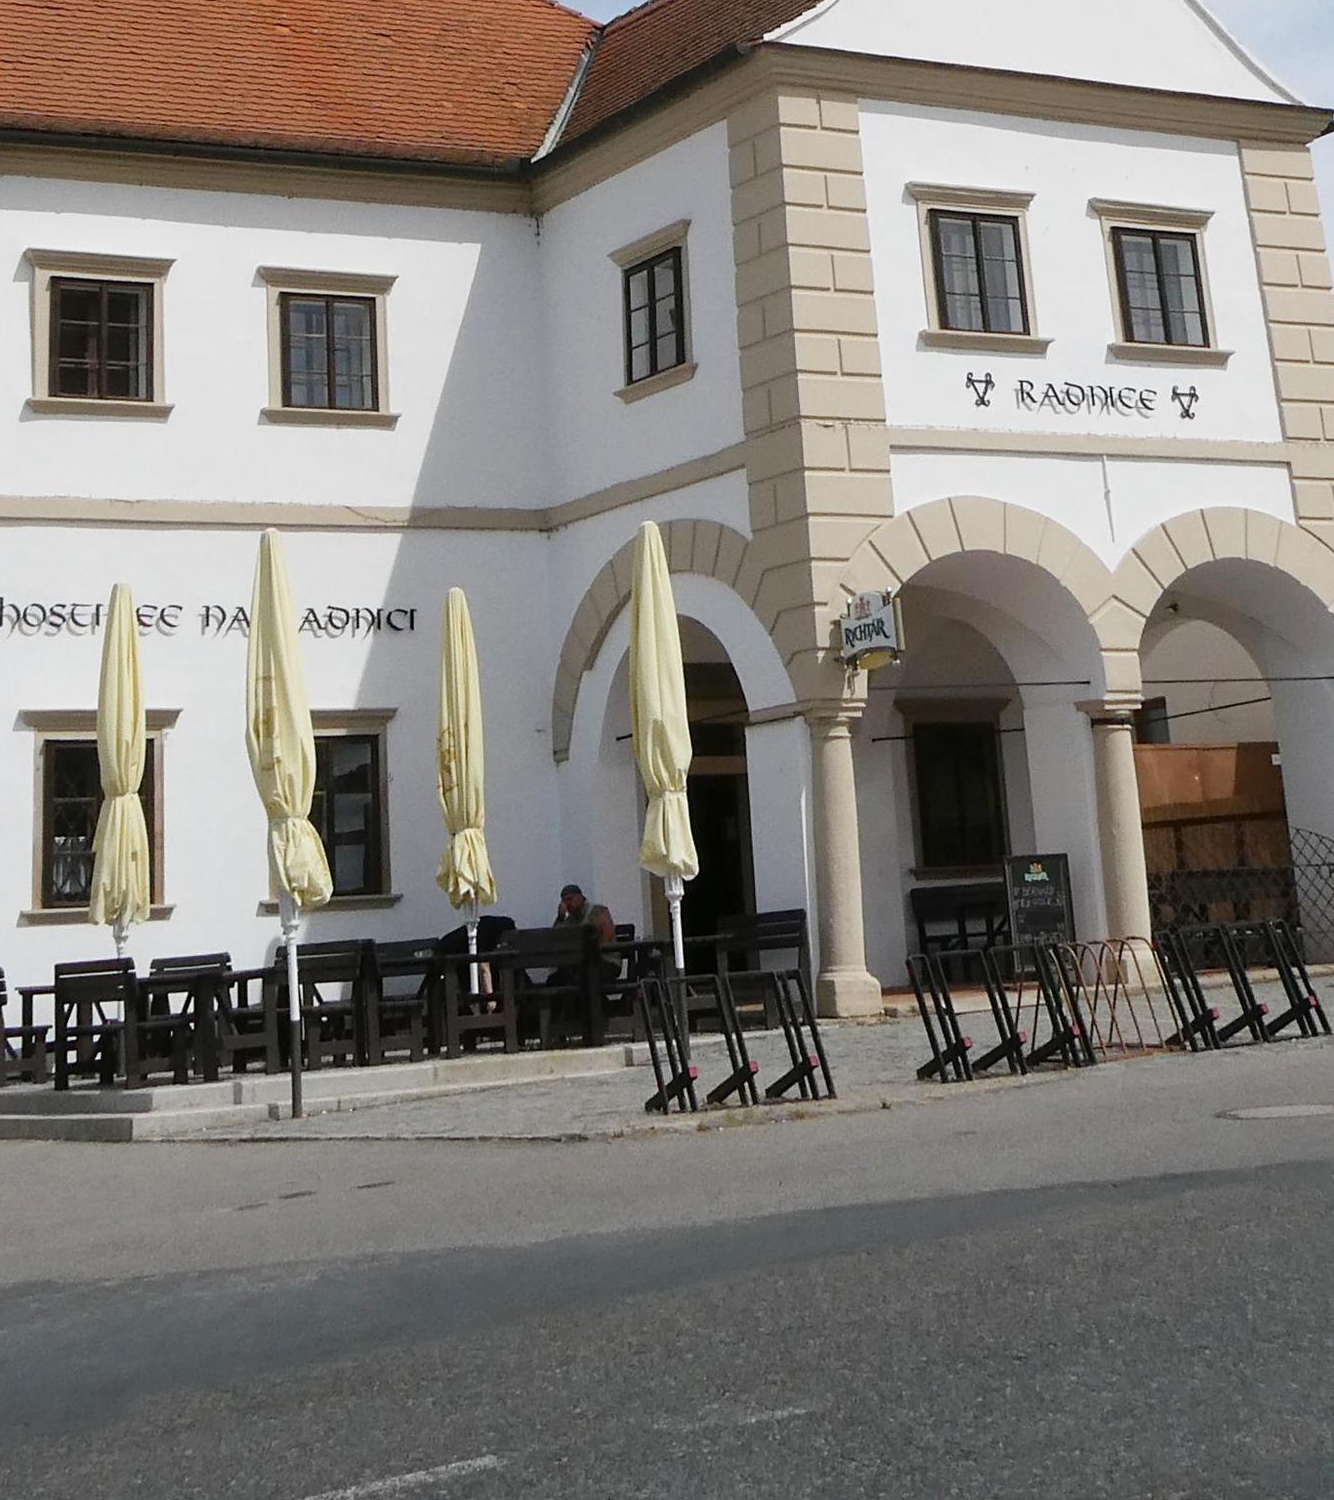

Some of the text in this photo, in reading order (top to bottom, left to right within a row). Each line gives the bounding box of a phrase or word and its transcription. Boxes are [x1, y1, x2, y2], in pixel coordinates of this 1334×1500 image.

[1018, 380, 1157, 414] RADNICE
[202, 604, 250, 636] NA
[298, 605, 417, 637] ADNICI
